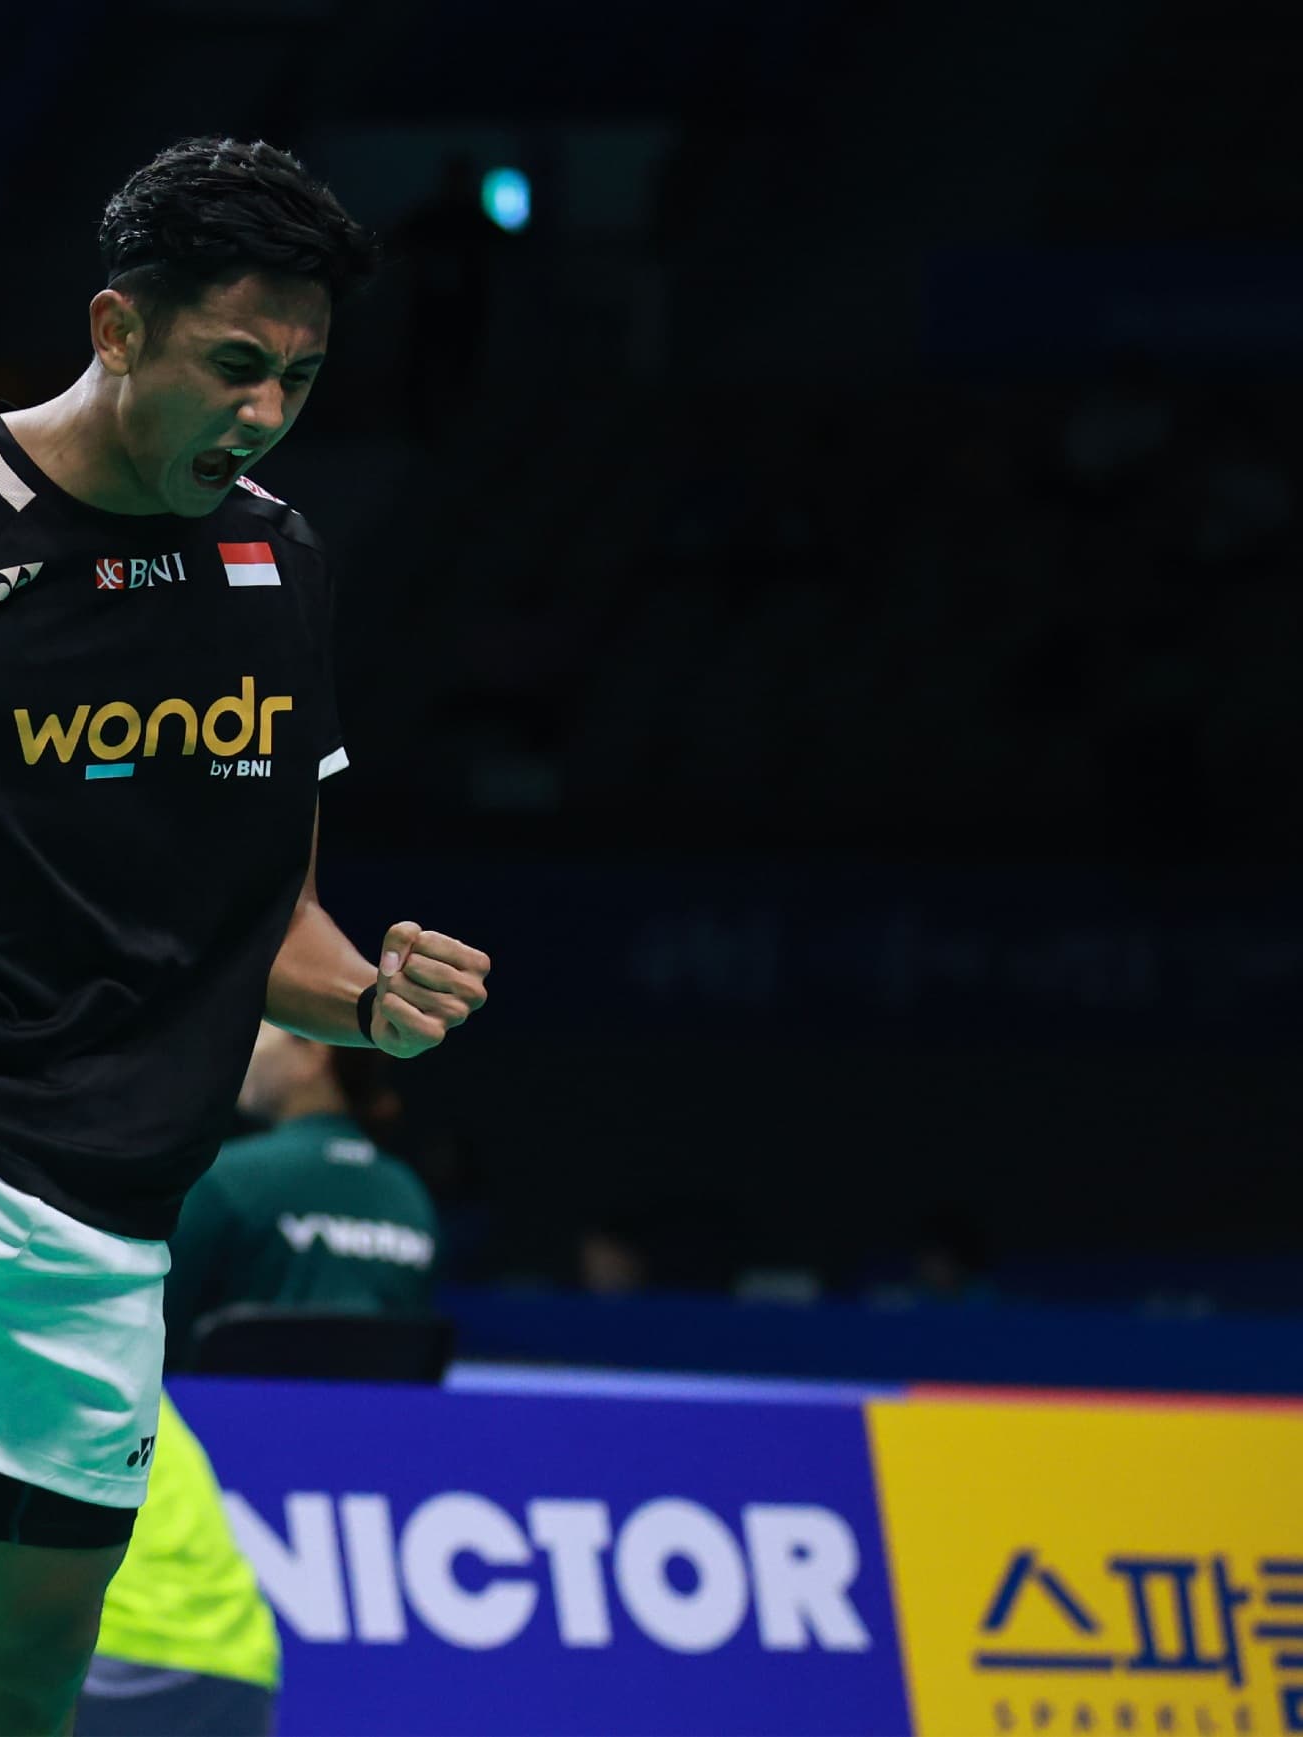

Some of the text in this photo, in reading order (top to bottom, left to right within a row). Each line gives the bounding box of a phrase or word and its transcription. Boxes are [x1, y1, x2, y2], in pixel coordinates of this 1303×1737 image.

[128, 552, 187, 589] BNI
[12, 675, 294, 766] wondr
[210, 759, 272, 780] by BNI
